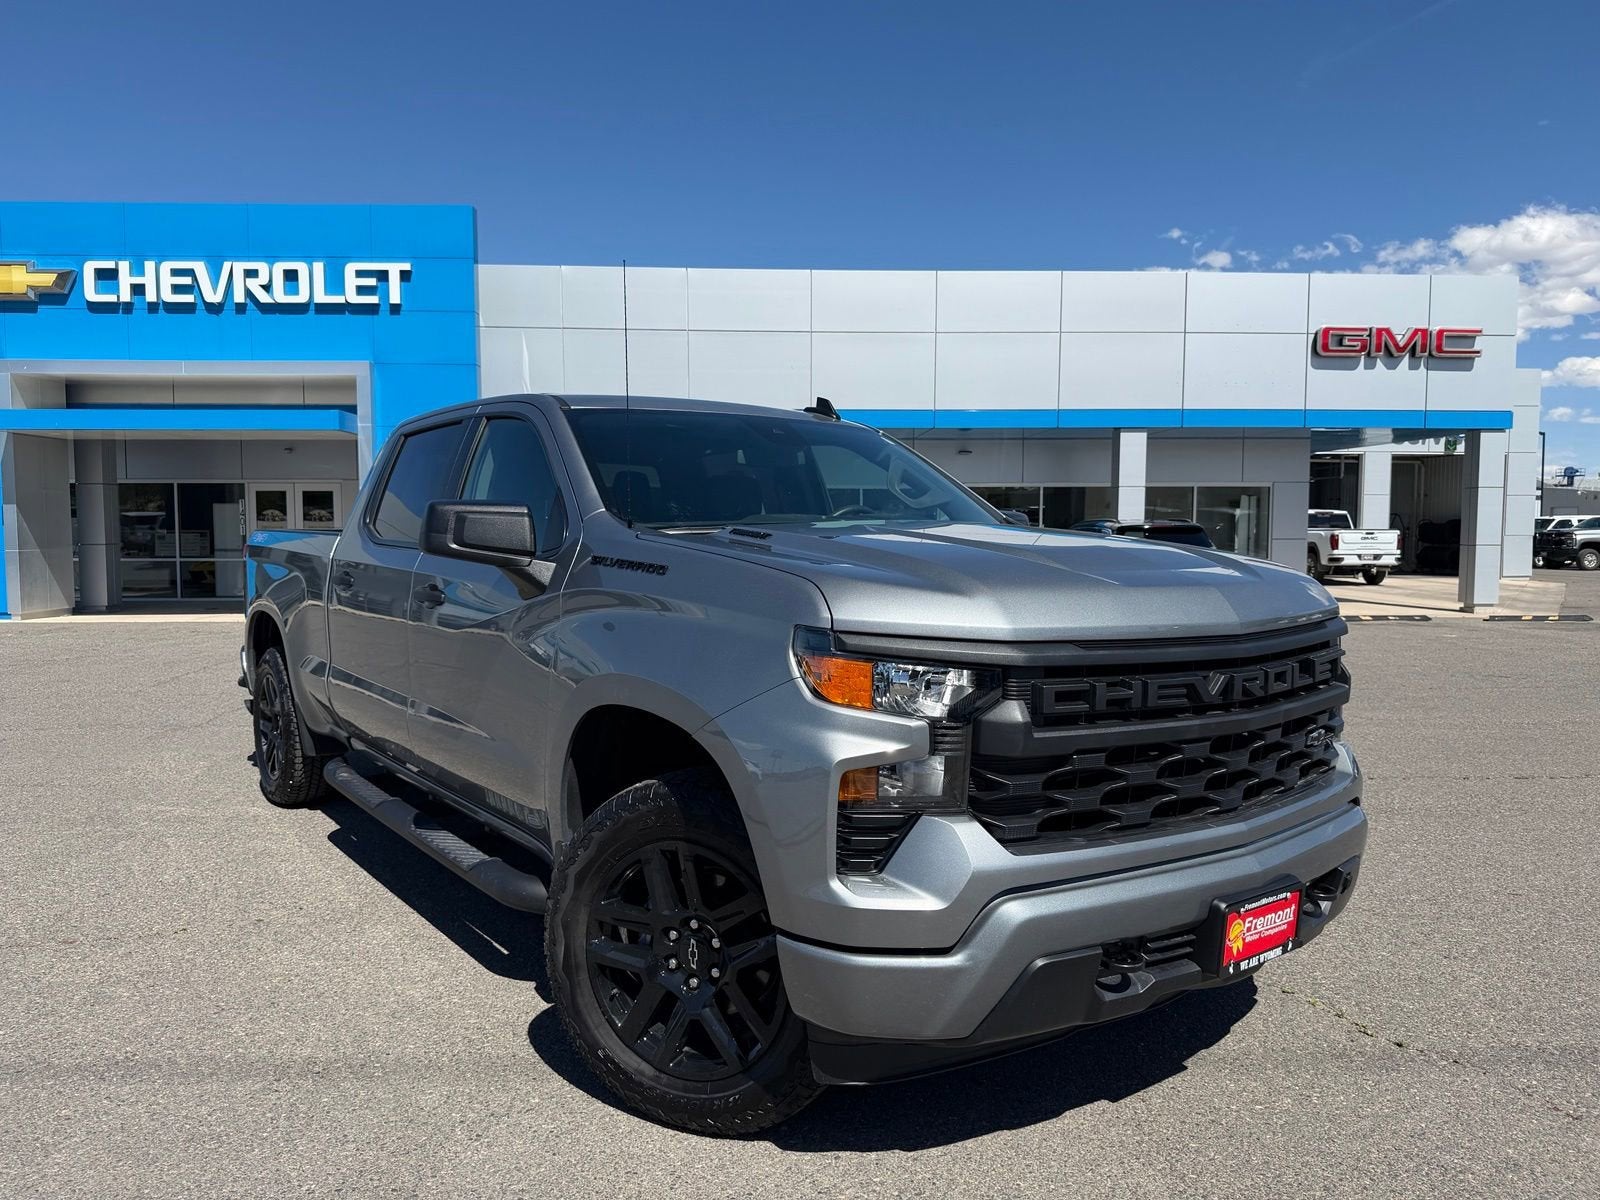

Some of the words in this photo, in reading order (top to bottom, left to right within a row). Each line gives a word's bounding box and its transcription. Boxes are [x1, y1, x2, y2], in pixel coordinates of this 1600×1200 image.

[83, 260, 412, 305] CHEVROLET
[1316, 326, 1483, 358] GMC
[590, 555, 669, 576] SILVERADO
[1244, 904, 1295, 932] Fremont
[1245, 933, 1260, 943] Motor
[1240, 960, 1249, 971] WE
[1249, 956, 1259, 967] ARE
[1260, 947, 1283, 962] WYOMING
